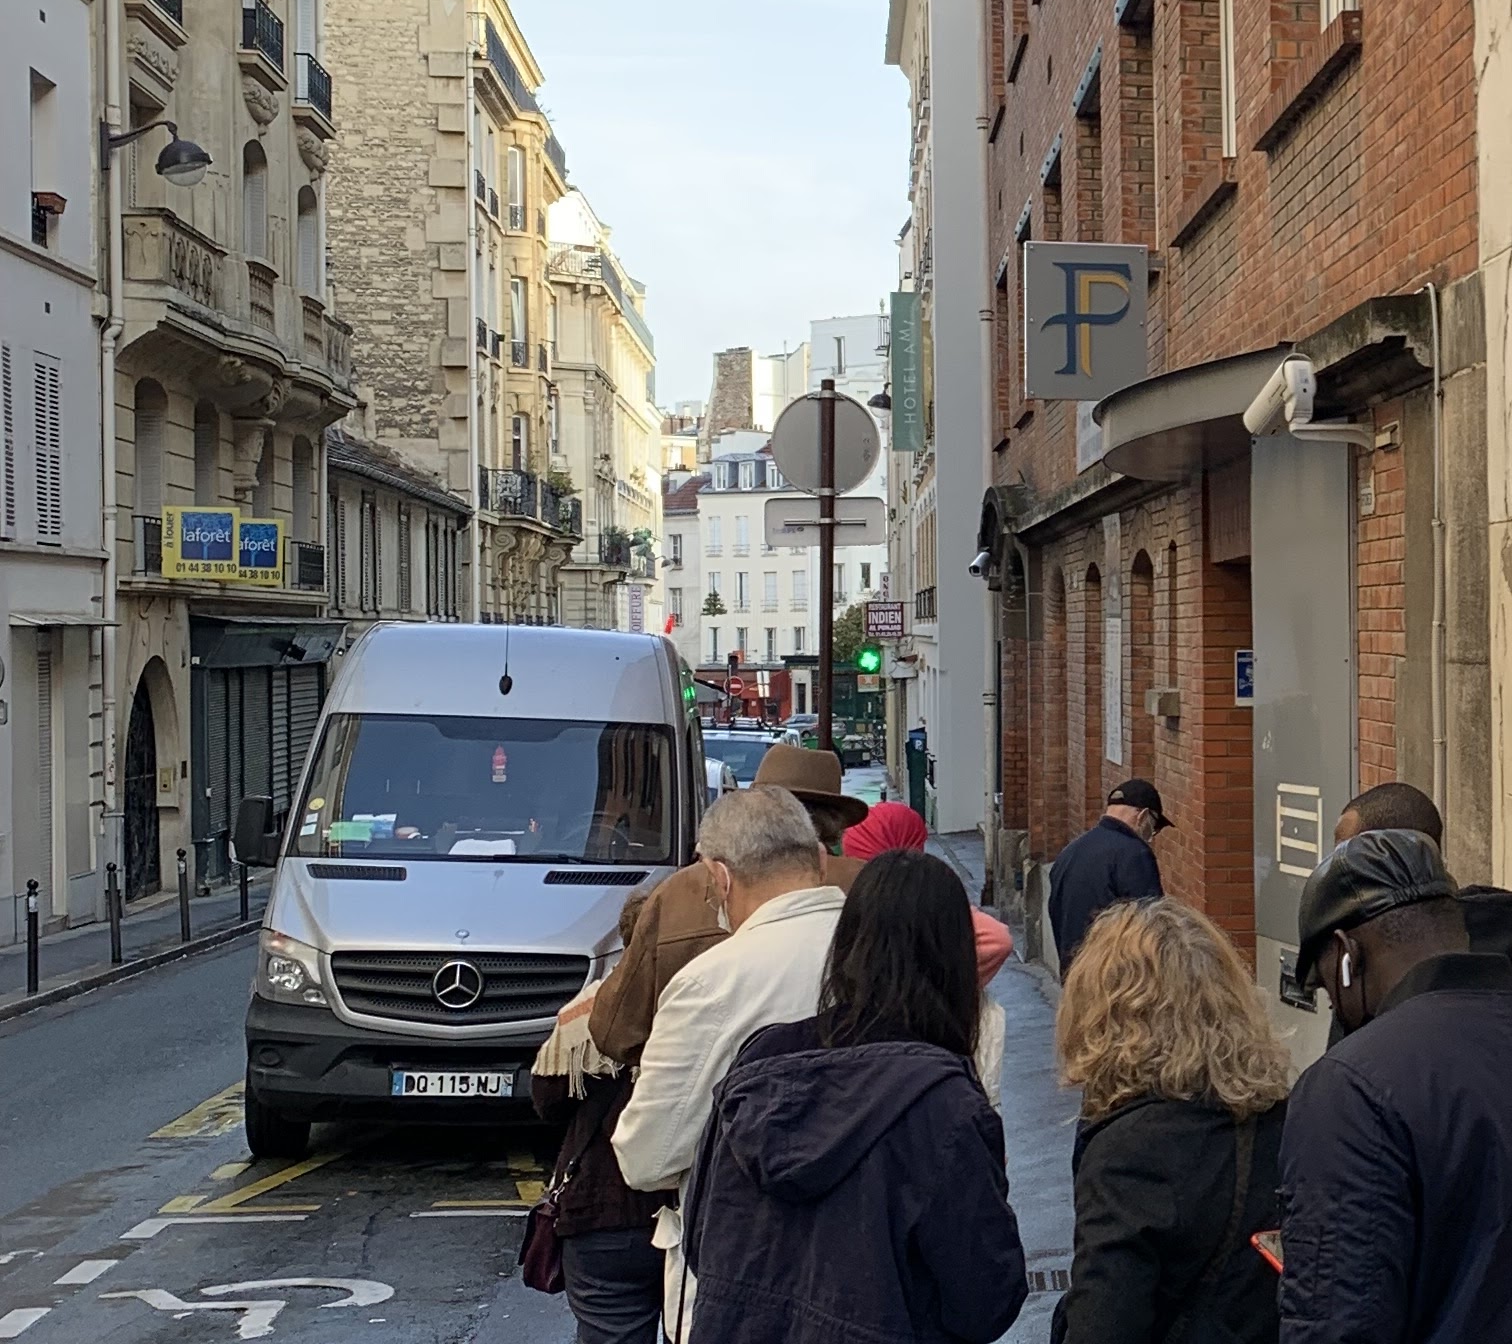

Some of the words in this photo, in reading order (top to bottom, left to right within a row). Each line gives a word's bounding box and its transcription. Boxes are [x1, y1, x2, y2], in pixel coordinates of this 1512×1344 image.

[903, 364, 917, 424] HOTEL
[163, 512, 174, 539] louer
[183, 527, 230, 542] laforêt
[239, 538, 275, 551] aforêt
[176, 562, 185, 572] 01
[188, 563, 199, 572] 44
[201, 563, 212, 573] 38
[214, 563, 224, 573] 10
[227, 563, 237, 573] 10
[260, 570, 269, 579] 10
[271, 570, 280, 580] 10
[631, 586, 641, 632] OIFFURE
[868, 611, 902, 624] INDIEN
